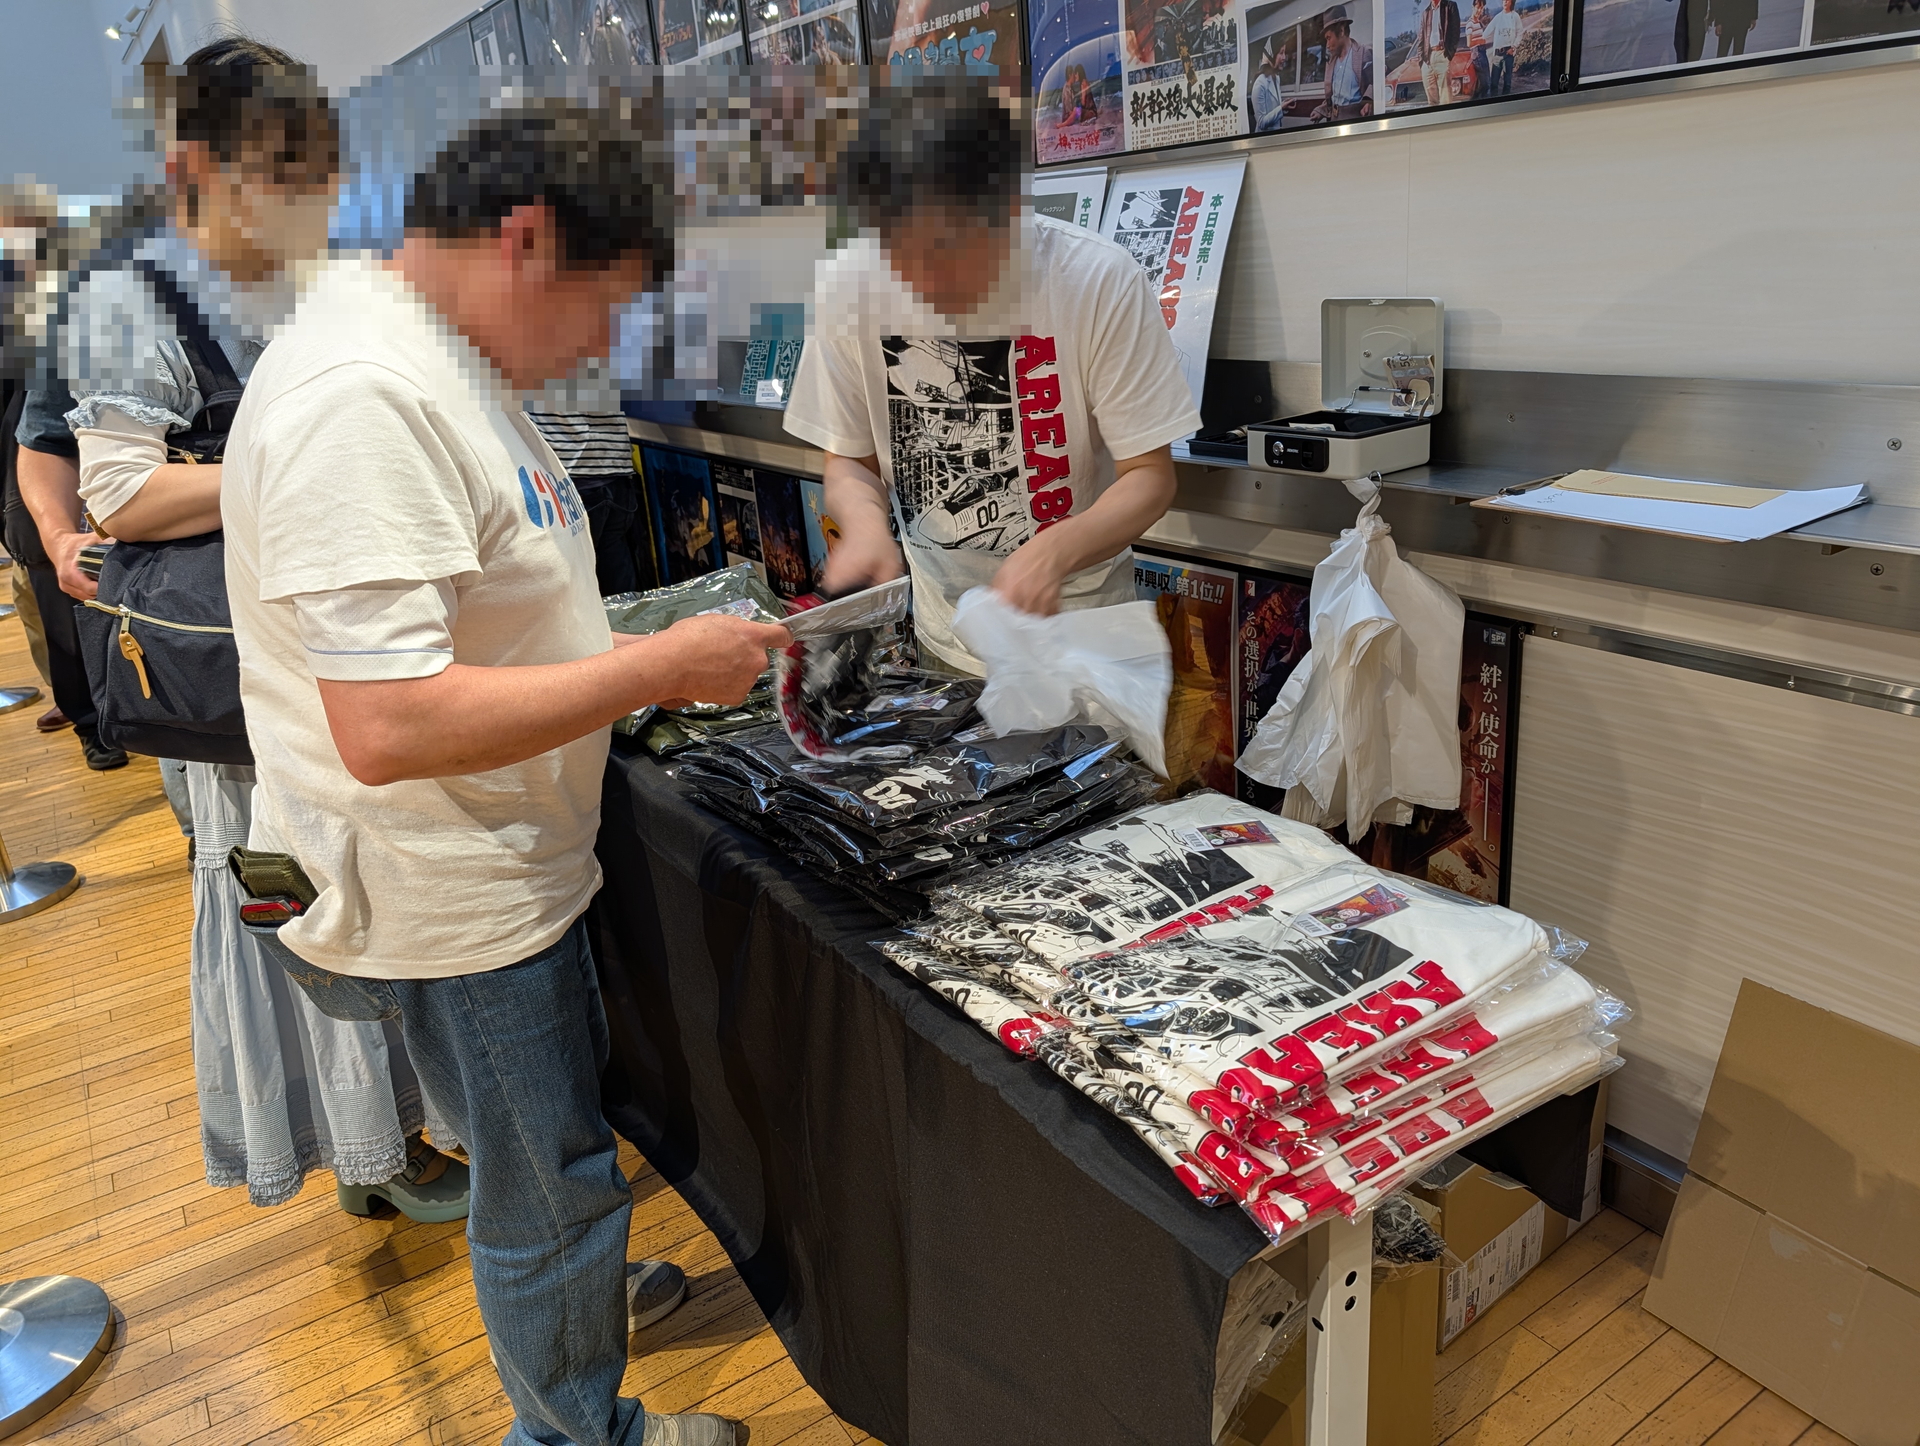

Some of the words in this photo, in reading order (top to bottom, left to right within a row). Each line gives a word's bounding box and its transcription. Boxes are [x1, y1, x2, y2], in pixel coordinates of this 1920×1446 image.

[1129, 74, 1239, 128] 新幹線大爆破
[1196, 193, 1224, 281] 本日発売！
[1013, 334, 1075, 536] AREA8
[976, 499, 999, 529] 00
[1491, 633, 1506, 643] SPY
